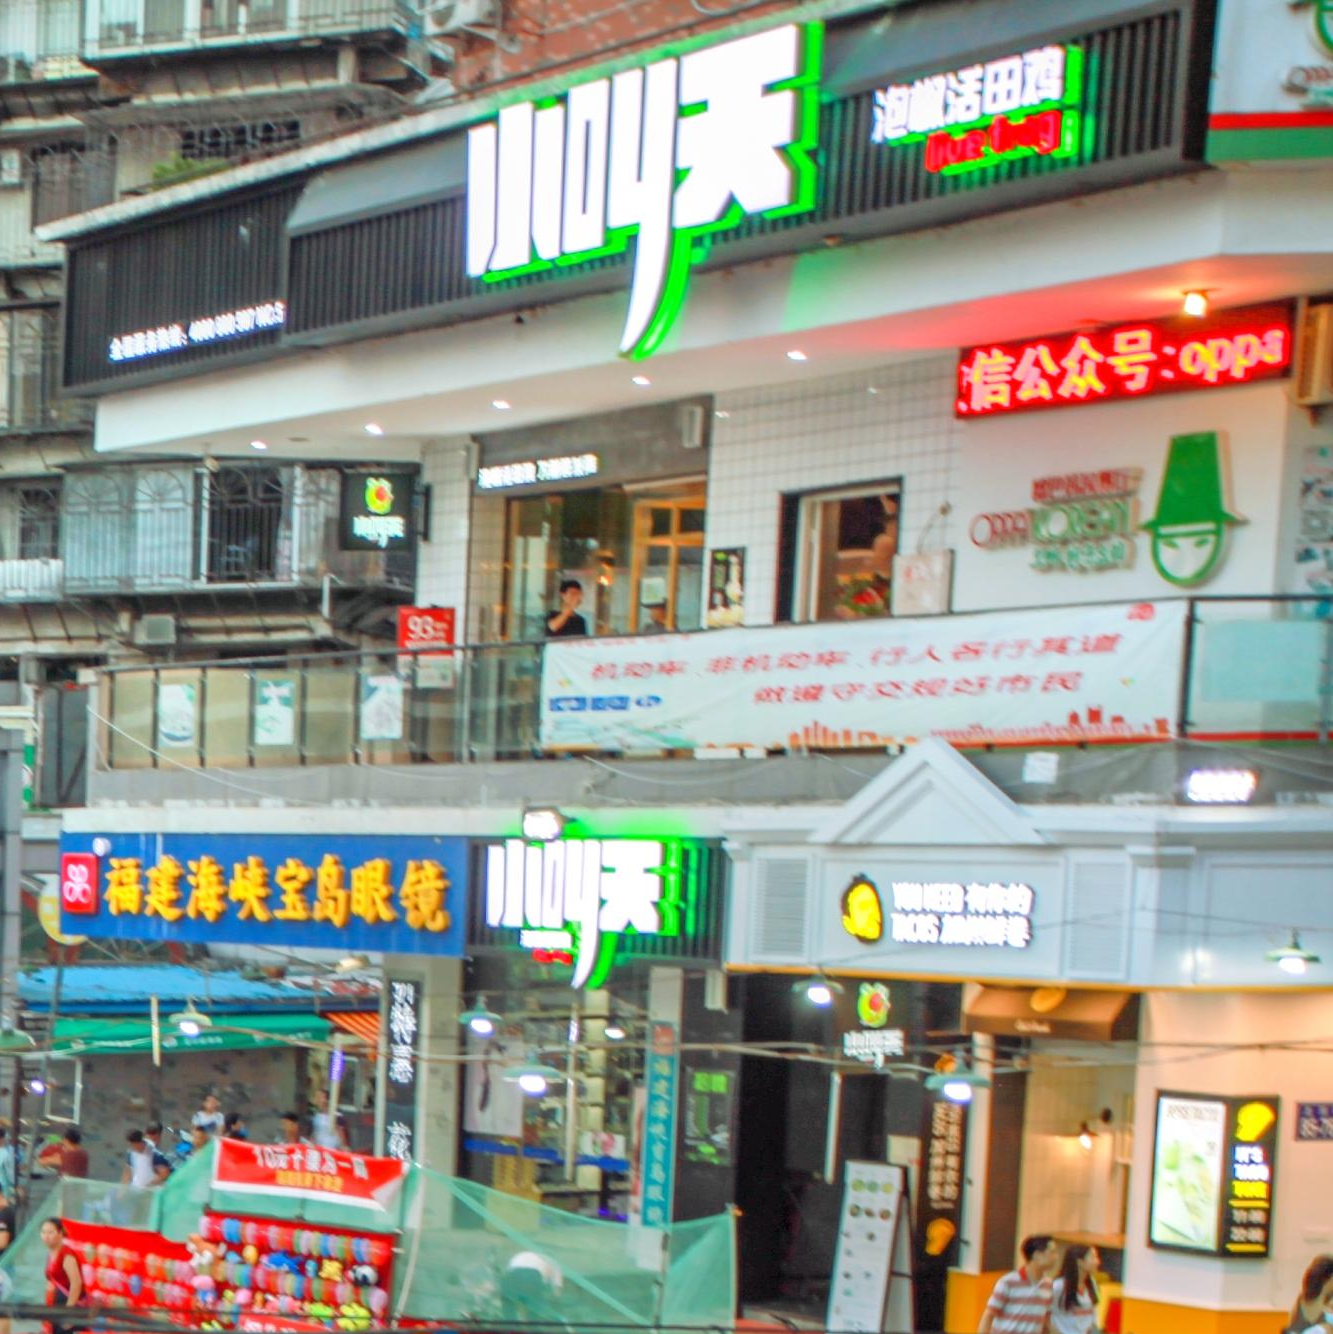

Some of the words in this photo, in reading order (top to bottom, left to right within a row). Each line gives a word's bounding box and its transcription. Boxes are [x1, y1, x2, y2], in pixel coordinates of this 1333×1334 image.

[104, 852, 451, 933] 福建海峡宝岛眼镜
